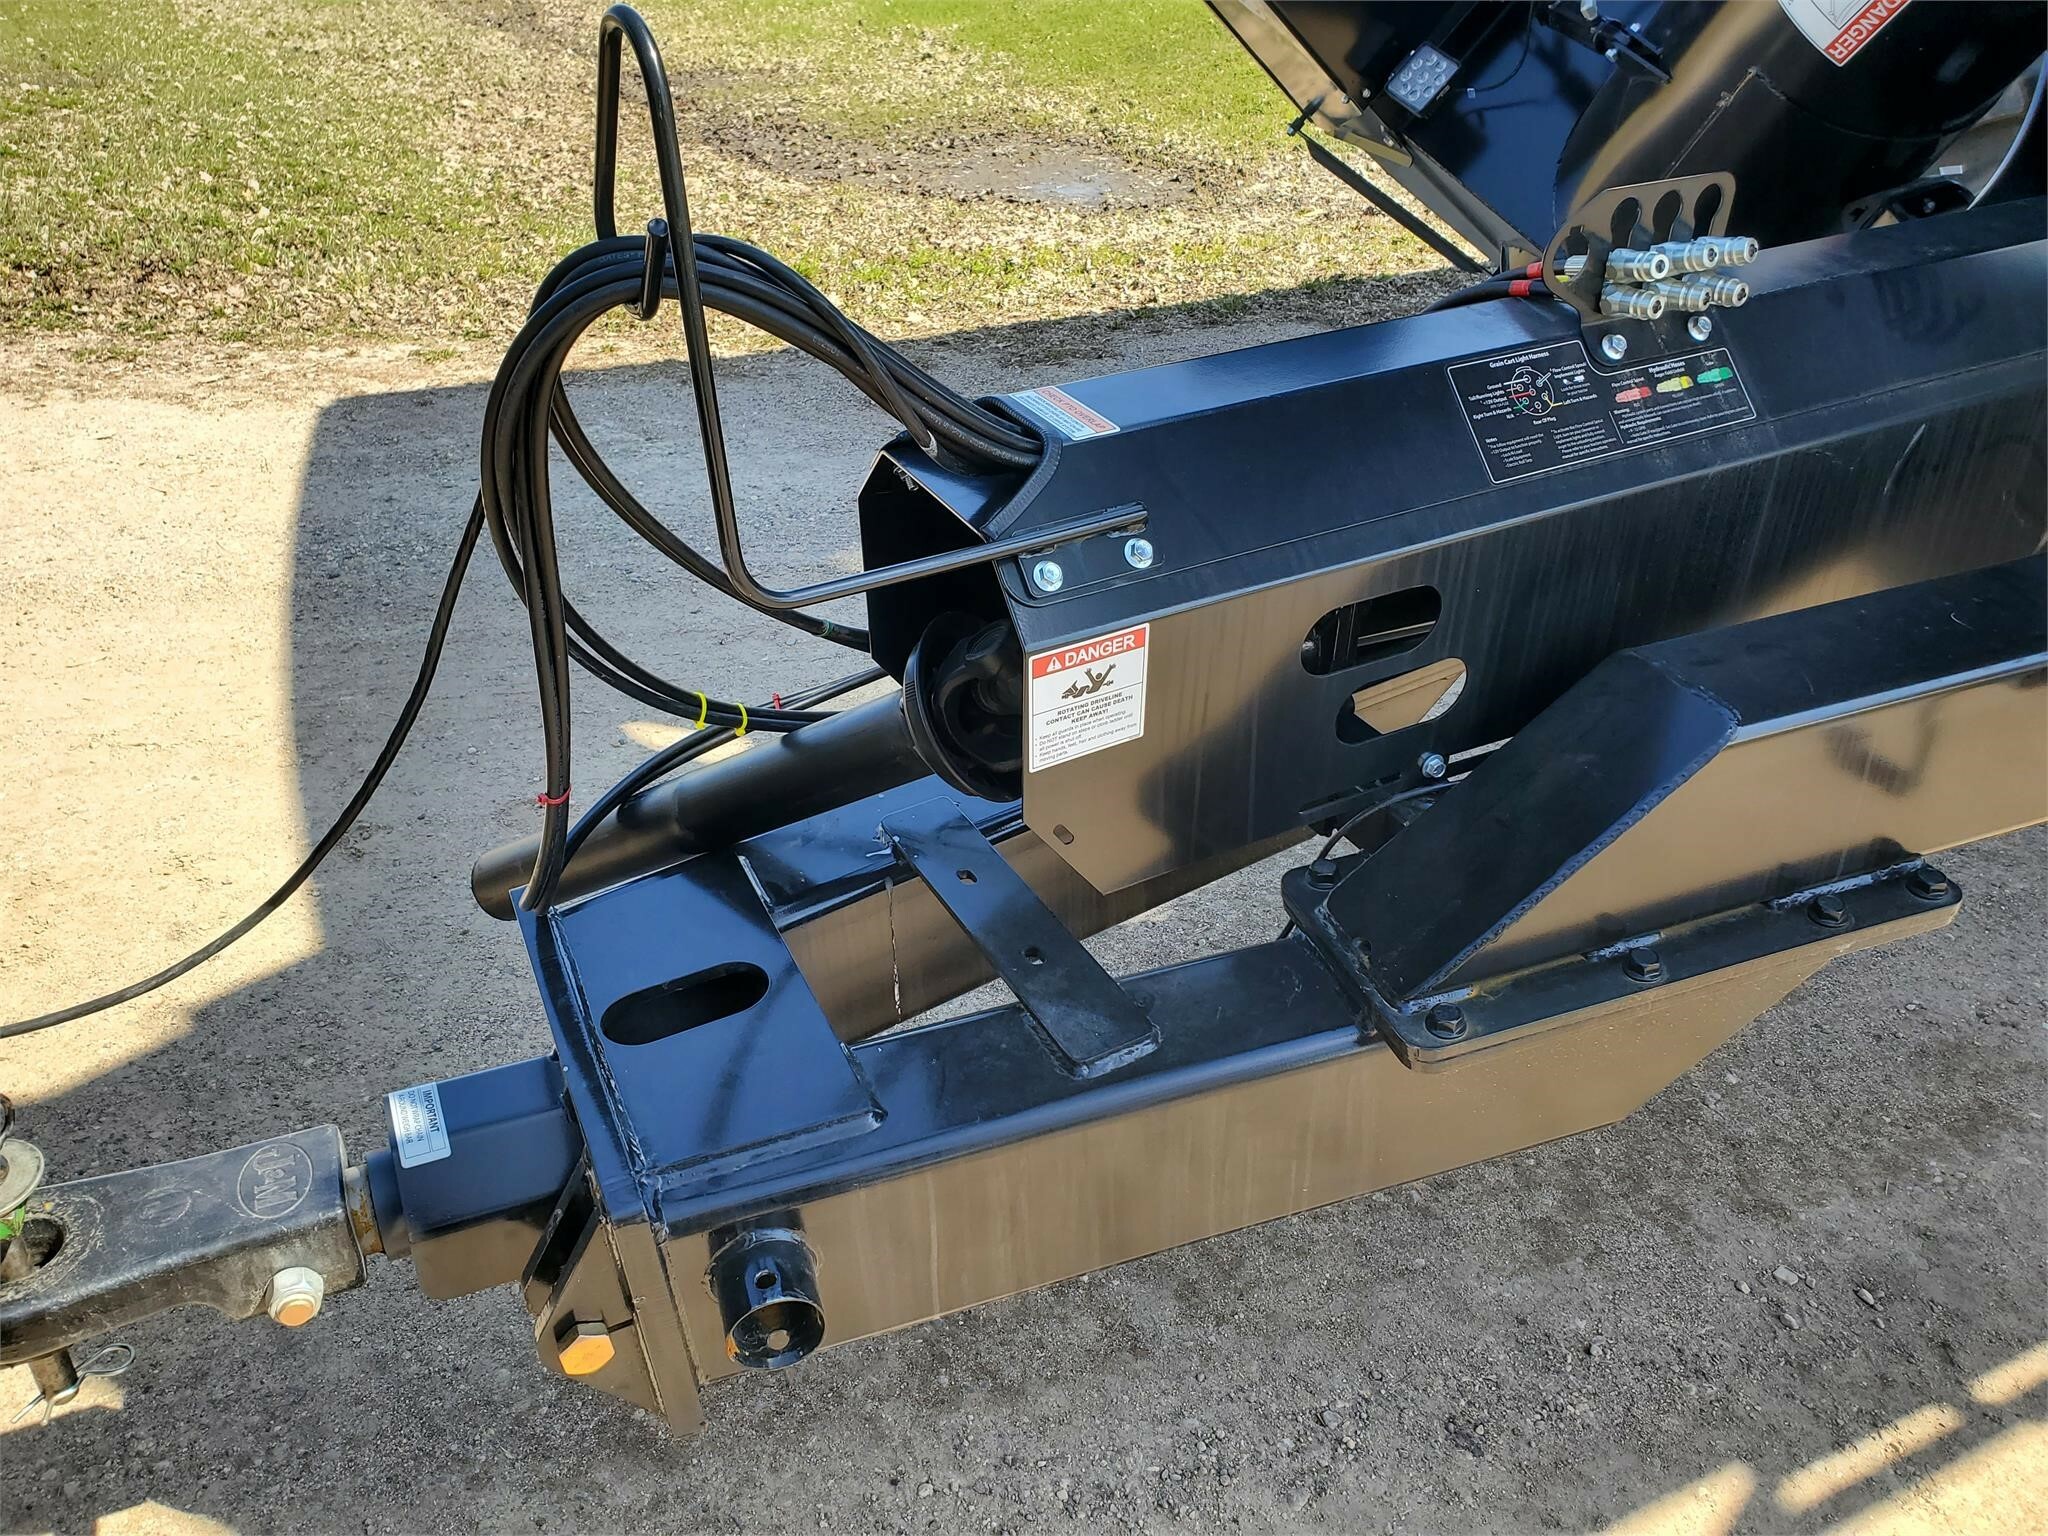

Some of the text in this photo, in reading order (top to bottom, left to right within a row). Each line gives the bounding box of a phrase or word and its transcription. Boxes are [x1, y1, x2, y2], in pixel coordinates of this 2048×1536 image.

[1489, 360, 1504, 368] Grain
[1515, 355, 1530, 364] Light
[1528, 351, 1550, 360] Harness
[1065, 634, 1136, 667] DANGER
[1046, 695, 1133, 726] CONTACT CAN CAUSE DEATH
[1058, 692, 1122, 716] ROTATING DRIVELINE
[1072, 715, 1087, 724] KEEP
[423, 1090, 439, 1132] IMPORTANT
